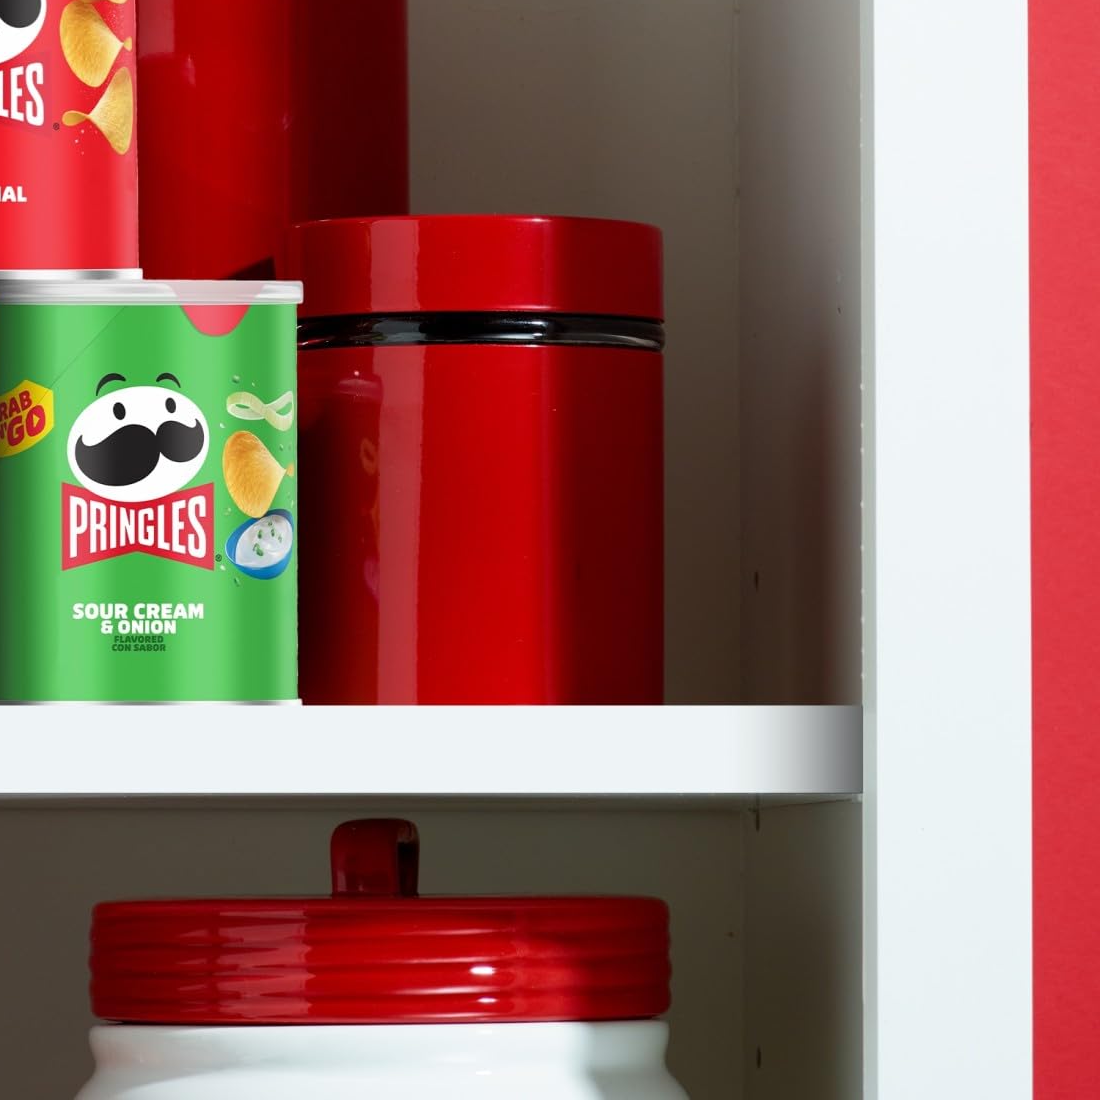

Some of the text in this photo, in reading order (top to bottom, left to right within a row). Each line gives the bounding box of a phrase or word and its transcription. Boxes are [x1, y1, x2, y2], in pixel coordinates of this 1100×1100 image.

[69, 495, 207, 559] PRINGLES
[72, 602, 205, 620] SOUR CREAM
[100, 619, 177, 635] & ONION
[111, 643, 166, 652] CON SABOR
[113, 635, 164, 644] FLAVORED
